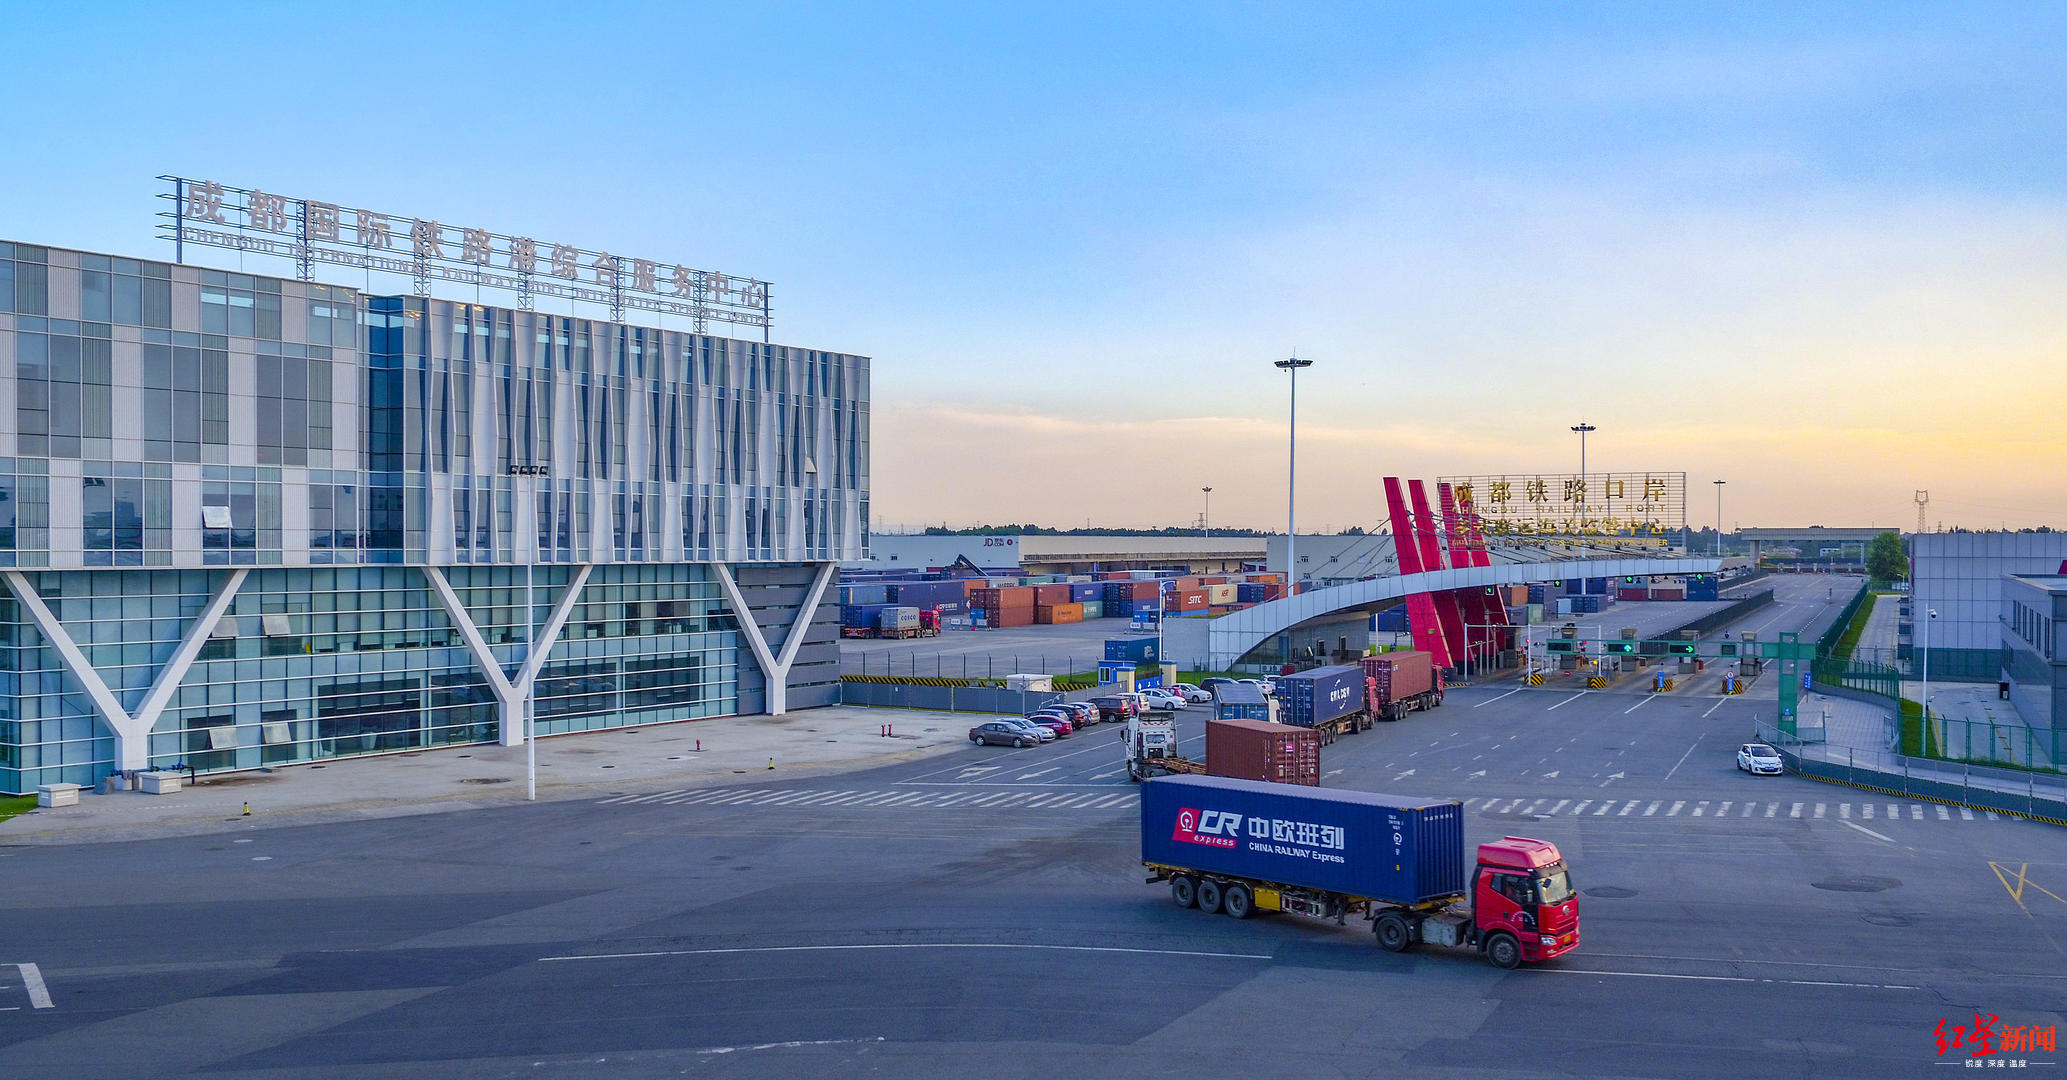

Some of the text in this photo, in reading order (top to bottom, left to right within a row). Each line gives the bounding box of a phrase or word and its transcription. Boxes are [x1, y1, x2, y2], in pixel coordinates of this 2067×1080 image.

[183, 226, 274, 253] CHENGDU
[185, 180, 764, 308] 成都国际铁路港综合服务中心
[1453, 479, 1666, 504] 成都铁路口岸
[1452, 504, 1667, 514] CHENGDU RAILWAY PORT
[1187, 595, 1203, 604] SITC
[1197, 810, 1243, 837] CR
[1248, 817, 1345, 850] 中欧班列
[1193, 834, 1235, 847] express
[1249, 842, 1345, 864] CHINA RAILWAY Express
